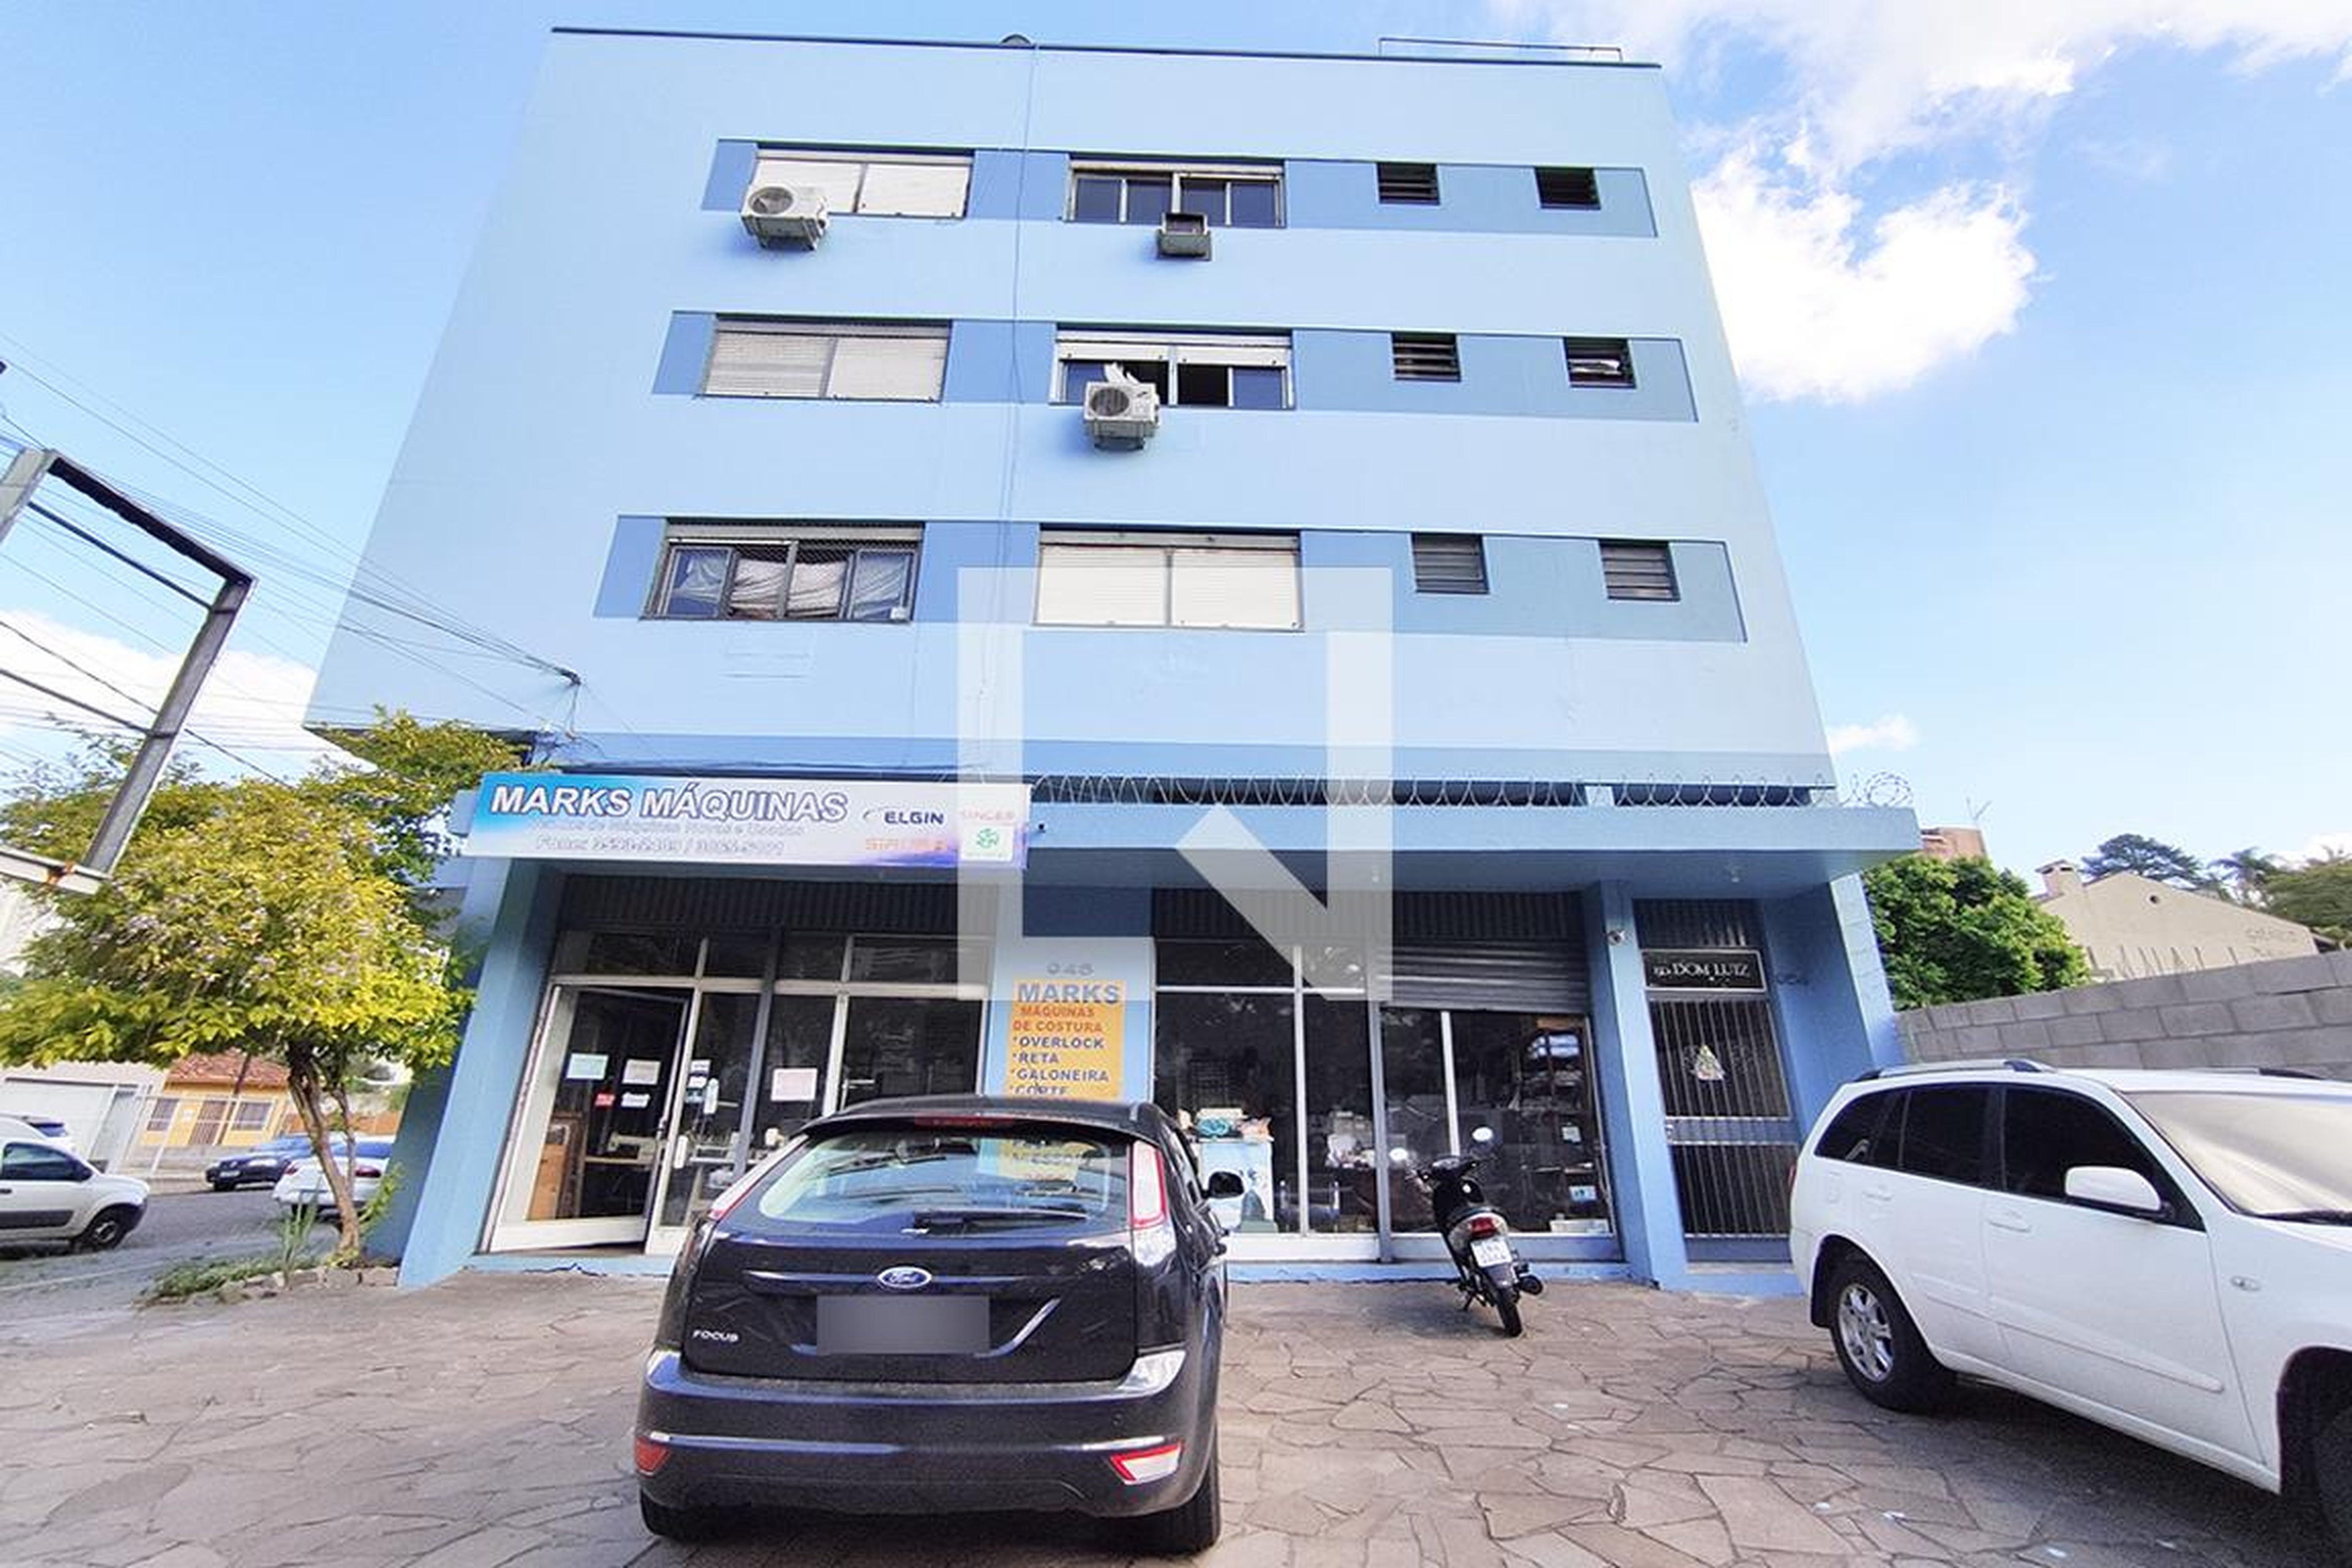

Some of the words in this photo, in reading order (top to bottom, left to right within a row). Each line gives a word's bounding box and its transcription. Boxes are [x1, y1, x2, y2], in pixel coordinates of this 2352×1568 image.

[491, 785, 631, 818] MARKS
[639, 782, 849, 823] MÁQUINAS
[884, 811, 944, 825] ELGIN
[1018, 983, 1120, 1005] MARKS
[1012, 1020, 1031, 1031] DE
[1036, 1020, 1102, 1032] COSTURA
[692, 1329, 739, 1343] FOCUS
